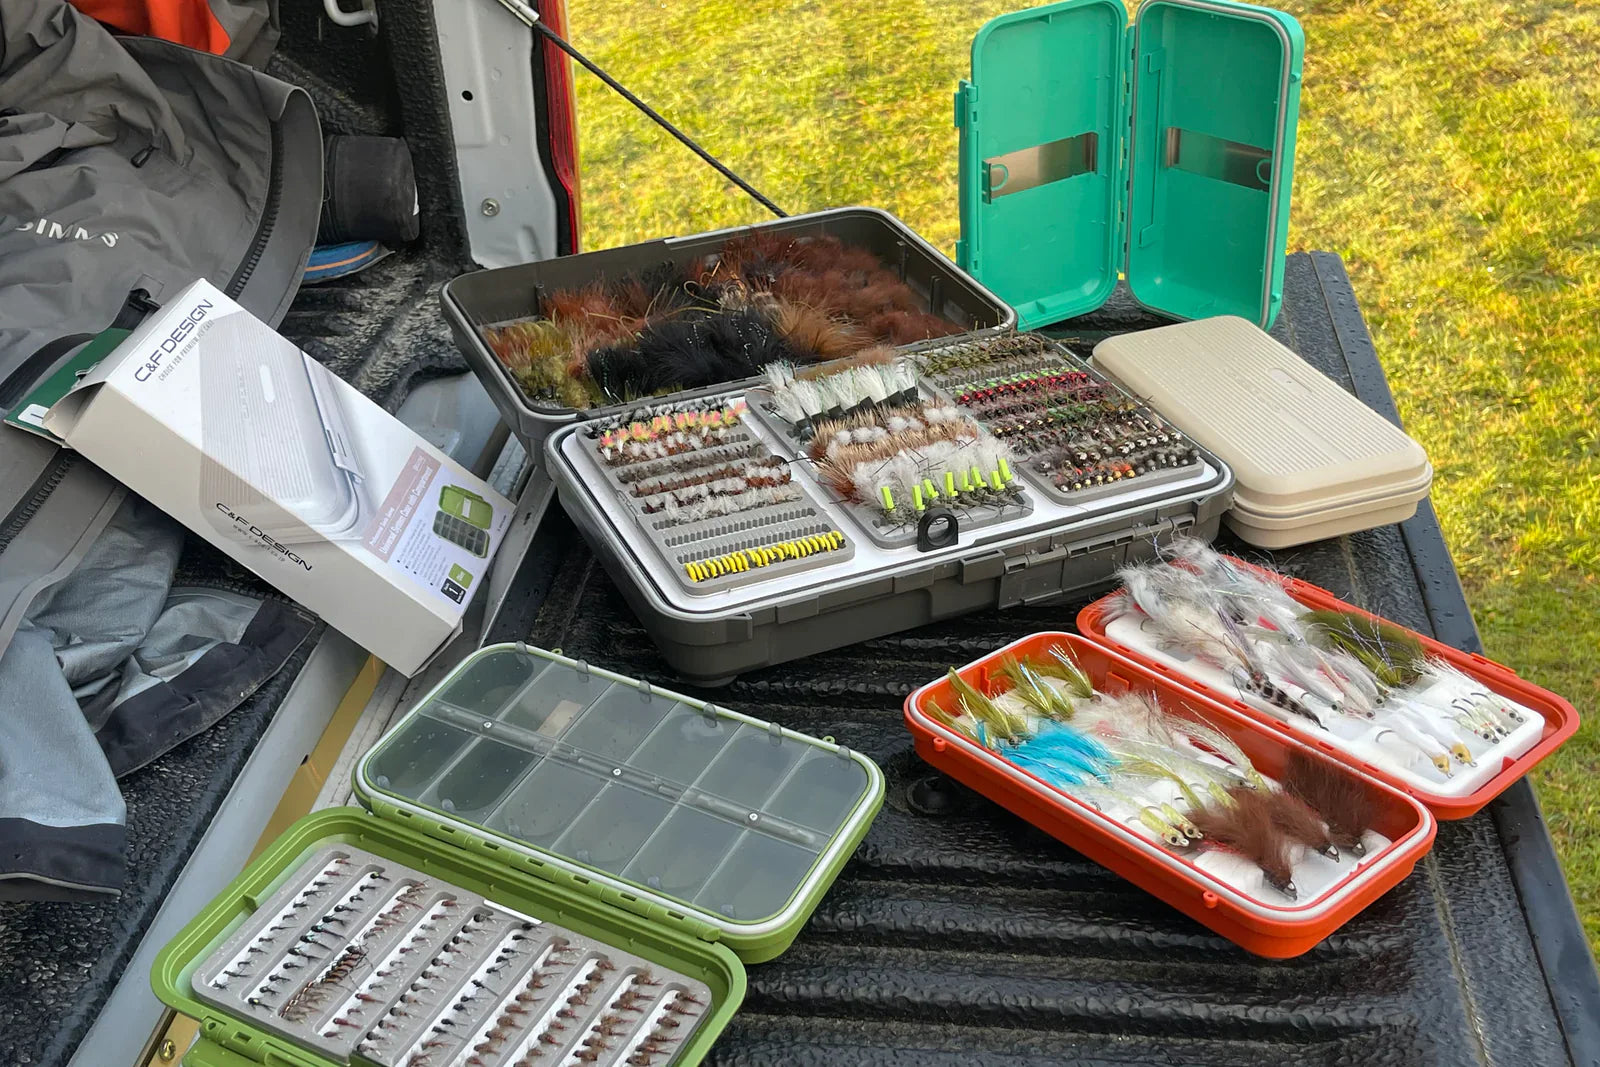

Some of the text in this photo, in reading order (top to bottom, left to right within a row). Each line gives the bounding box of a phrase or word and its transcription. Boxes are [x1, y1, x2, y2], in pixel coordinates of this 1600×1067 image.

[134, 298, 214, 382] C&F DESIGN
[216, 502, 313, 571] C&F DESIGN
